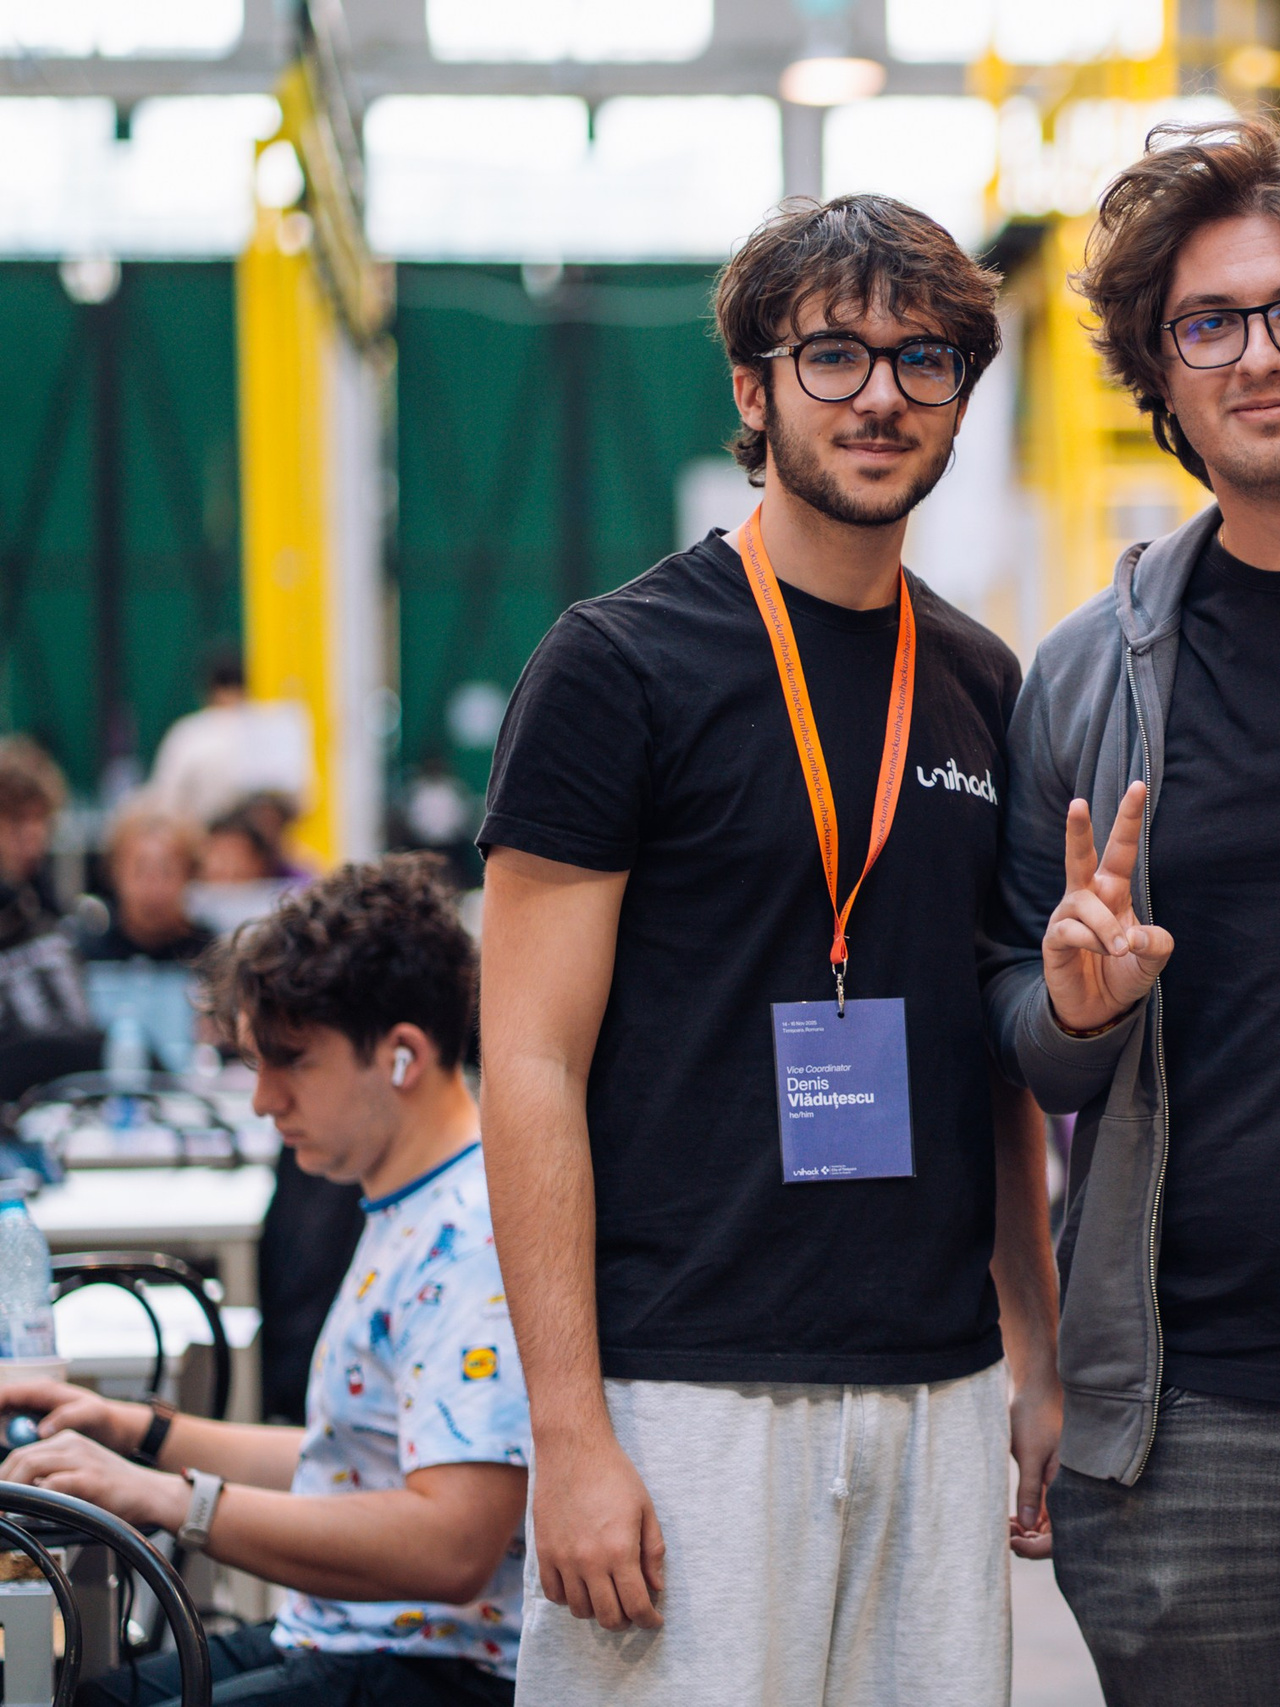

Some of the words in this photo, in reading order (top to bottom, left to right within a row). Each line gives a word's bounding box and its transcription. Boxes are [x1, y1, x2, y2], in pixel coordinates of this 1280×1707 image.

[916, 757, 998, 806] unihack
[786, 1066, 804, 1074] Vice
[805, 1063, 852, 1073] Coordinator
[786, 1076, 830, 1092] Denis
[789, 1111, 815, 1119] he/him
